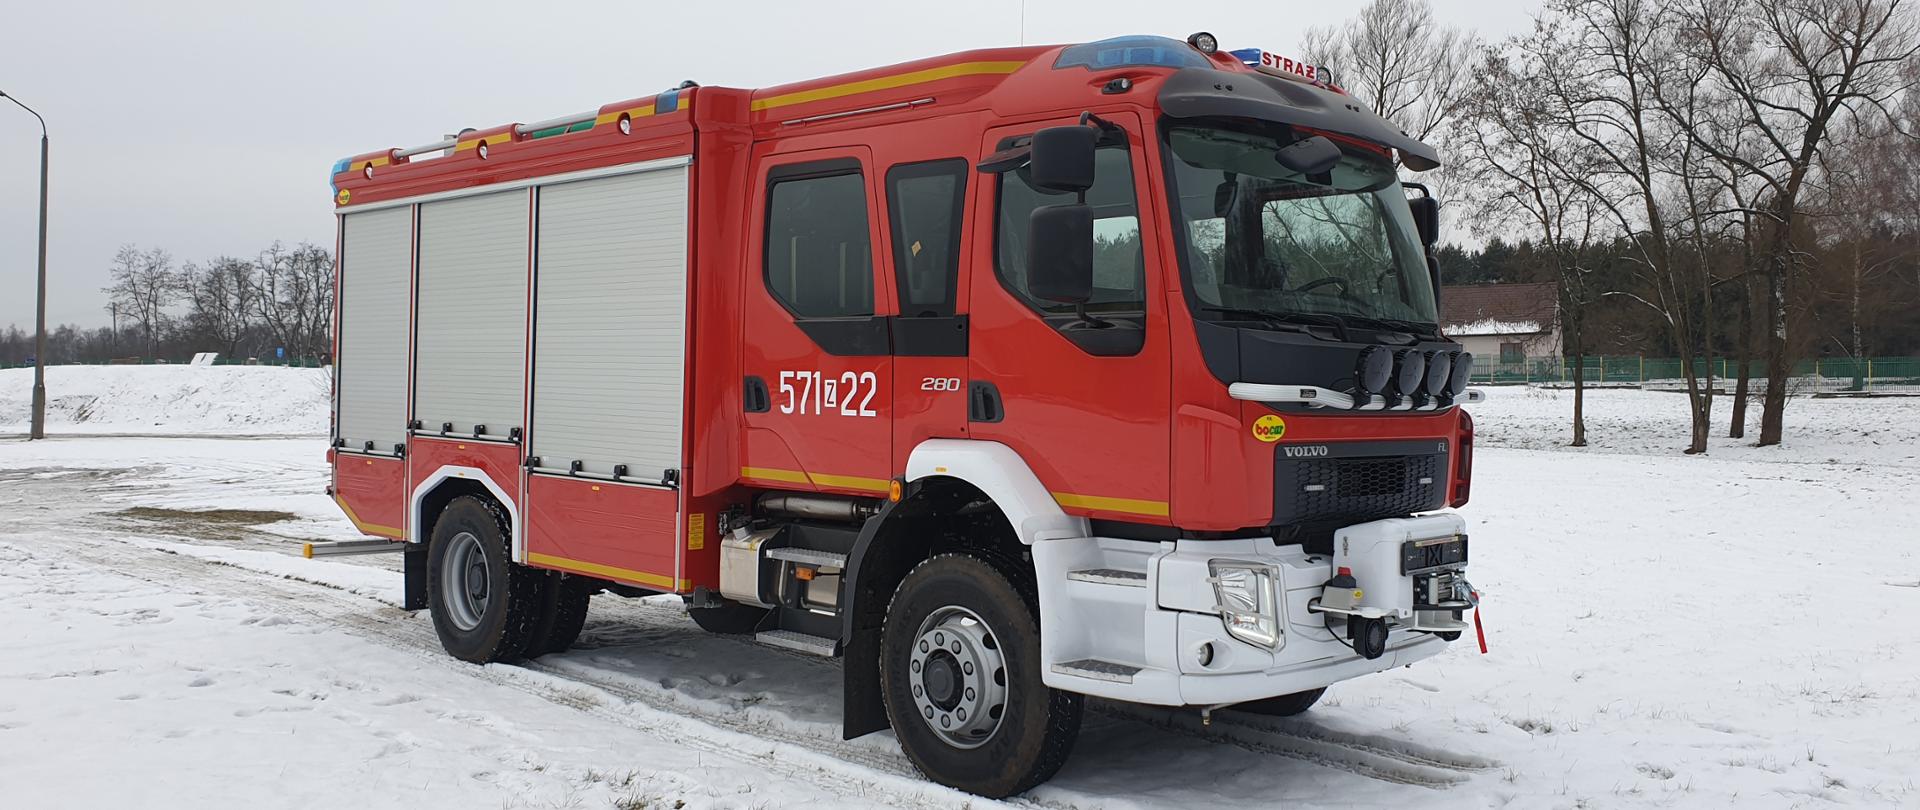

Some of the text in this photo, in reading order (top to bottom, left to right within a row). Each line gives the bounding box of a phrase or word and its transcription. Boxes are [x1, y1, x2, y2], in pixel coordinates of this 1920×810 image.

[921, 377, 961, 391] 280
[780, 371, 877, 417] 571 Z 22
[1284, 445, 1328, 457] VOLVO
[1437, 442, 1447, 452] FL
